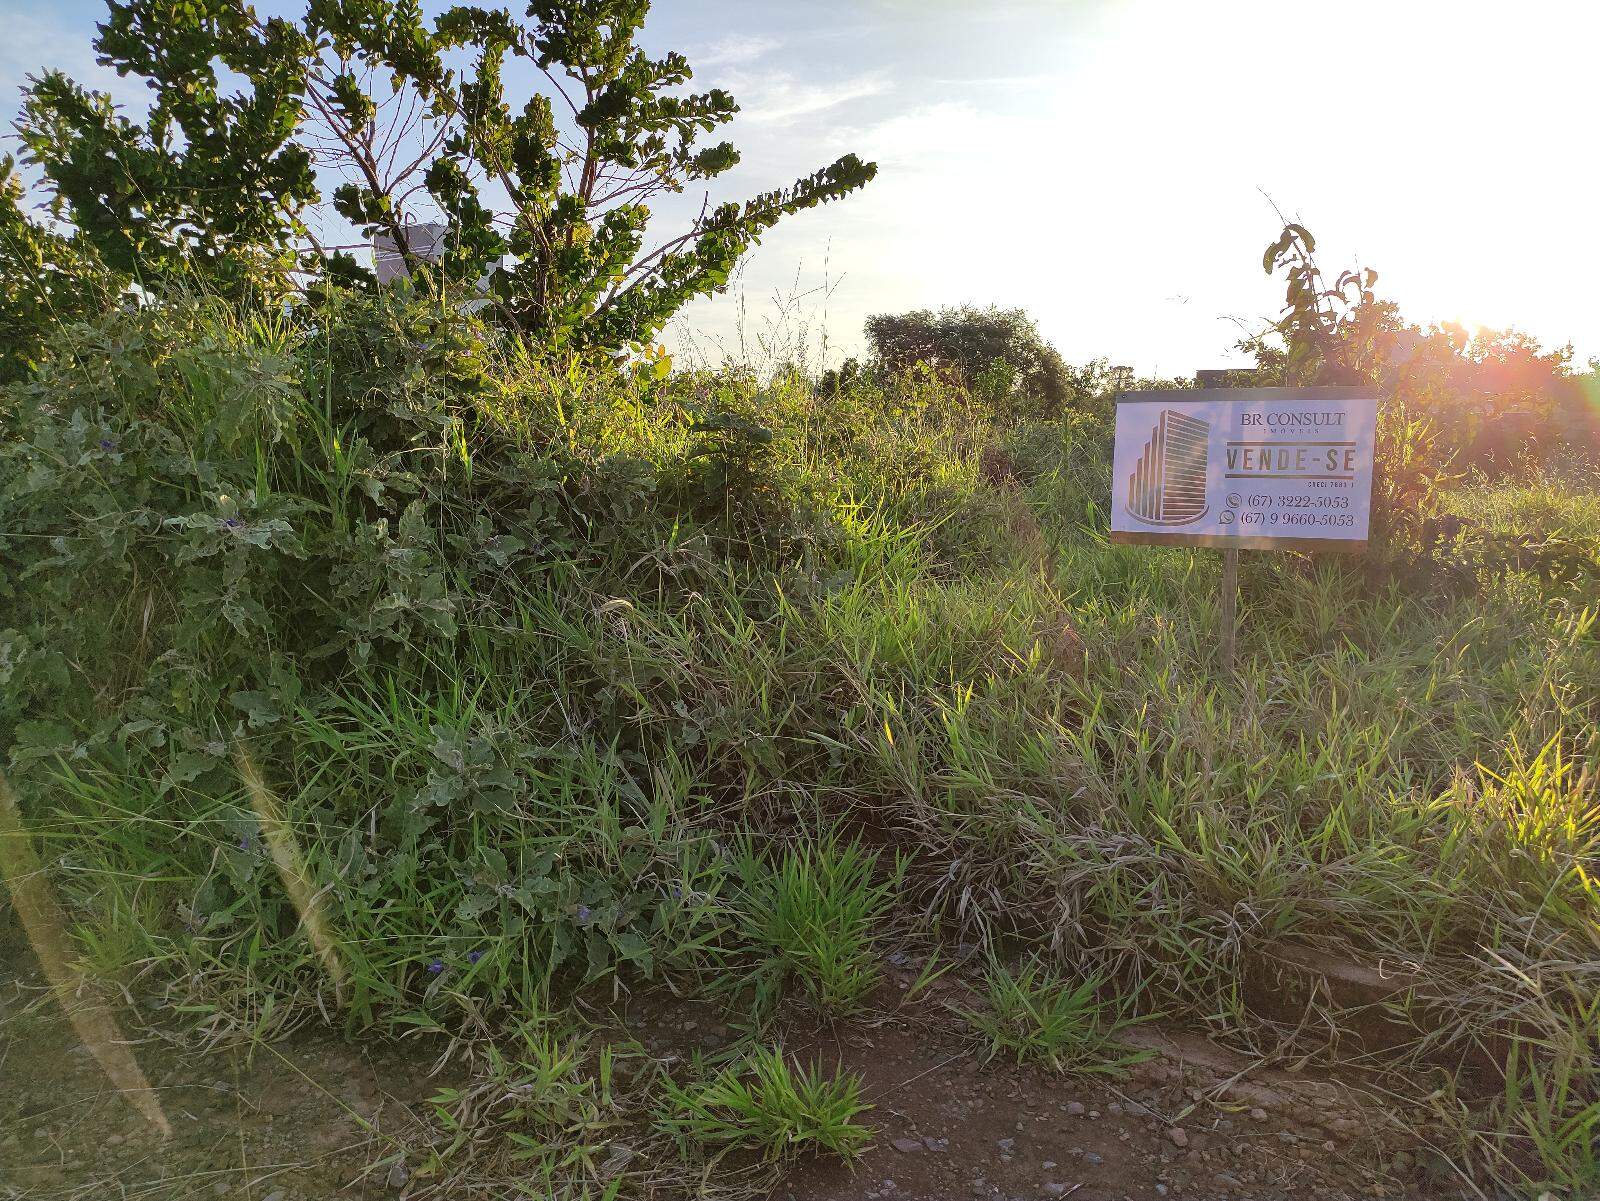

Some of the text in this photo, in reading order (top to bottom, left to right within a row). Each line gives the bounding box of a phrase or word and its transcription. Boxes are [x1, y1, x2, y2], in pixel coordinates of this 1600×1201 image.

[1241, 412, 1346, 426] BR CONSULT
[1226, 448, 1356, 471] VENDE-SE
[1248, 495, 1349, 509] (67) 3222-5053
[1241, 512, 1354, 527] (67) 9 9660-5053
